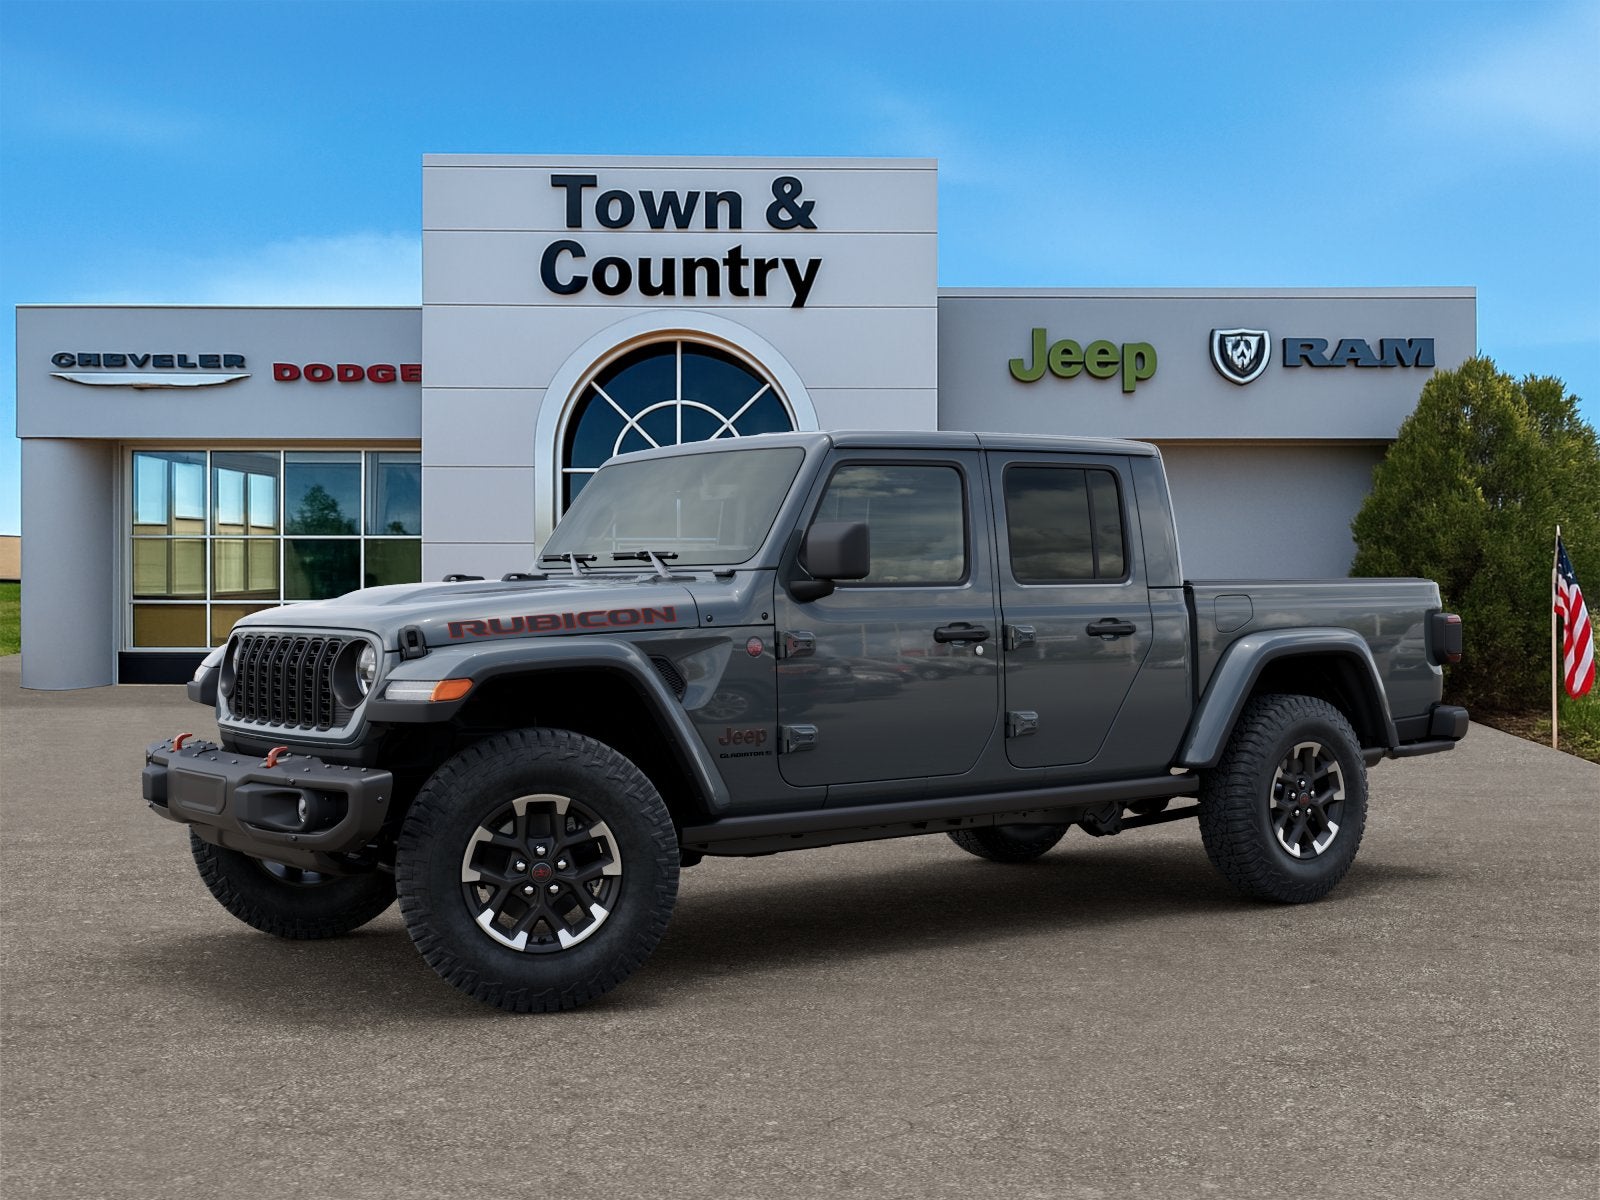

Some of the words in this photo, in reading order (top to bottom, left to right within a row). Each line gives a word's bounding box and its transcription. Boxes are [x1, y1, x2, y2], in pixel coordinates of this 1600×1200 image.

[550, 174, 742, 229] Town
[765, 176, 818, 230] &
[540, 239, 822, 308] Country
[1009, 328, 1157, 393] Jeep
[1282, 337, 1436, 368] RAM
[273, 362, 422, 383] DODGE
[448, 606, 677, 639] RUBICON
[718, 727, 767, 747] Jeep
[720, 751, 765, 759] GLADIATOR
